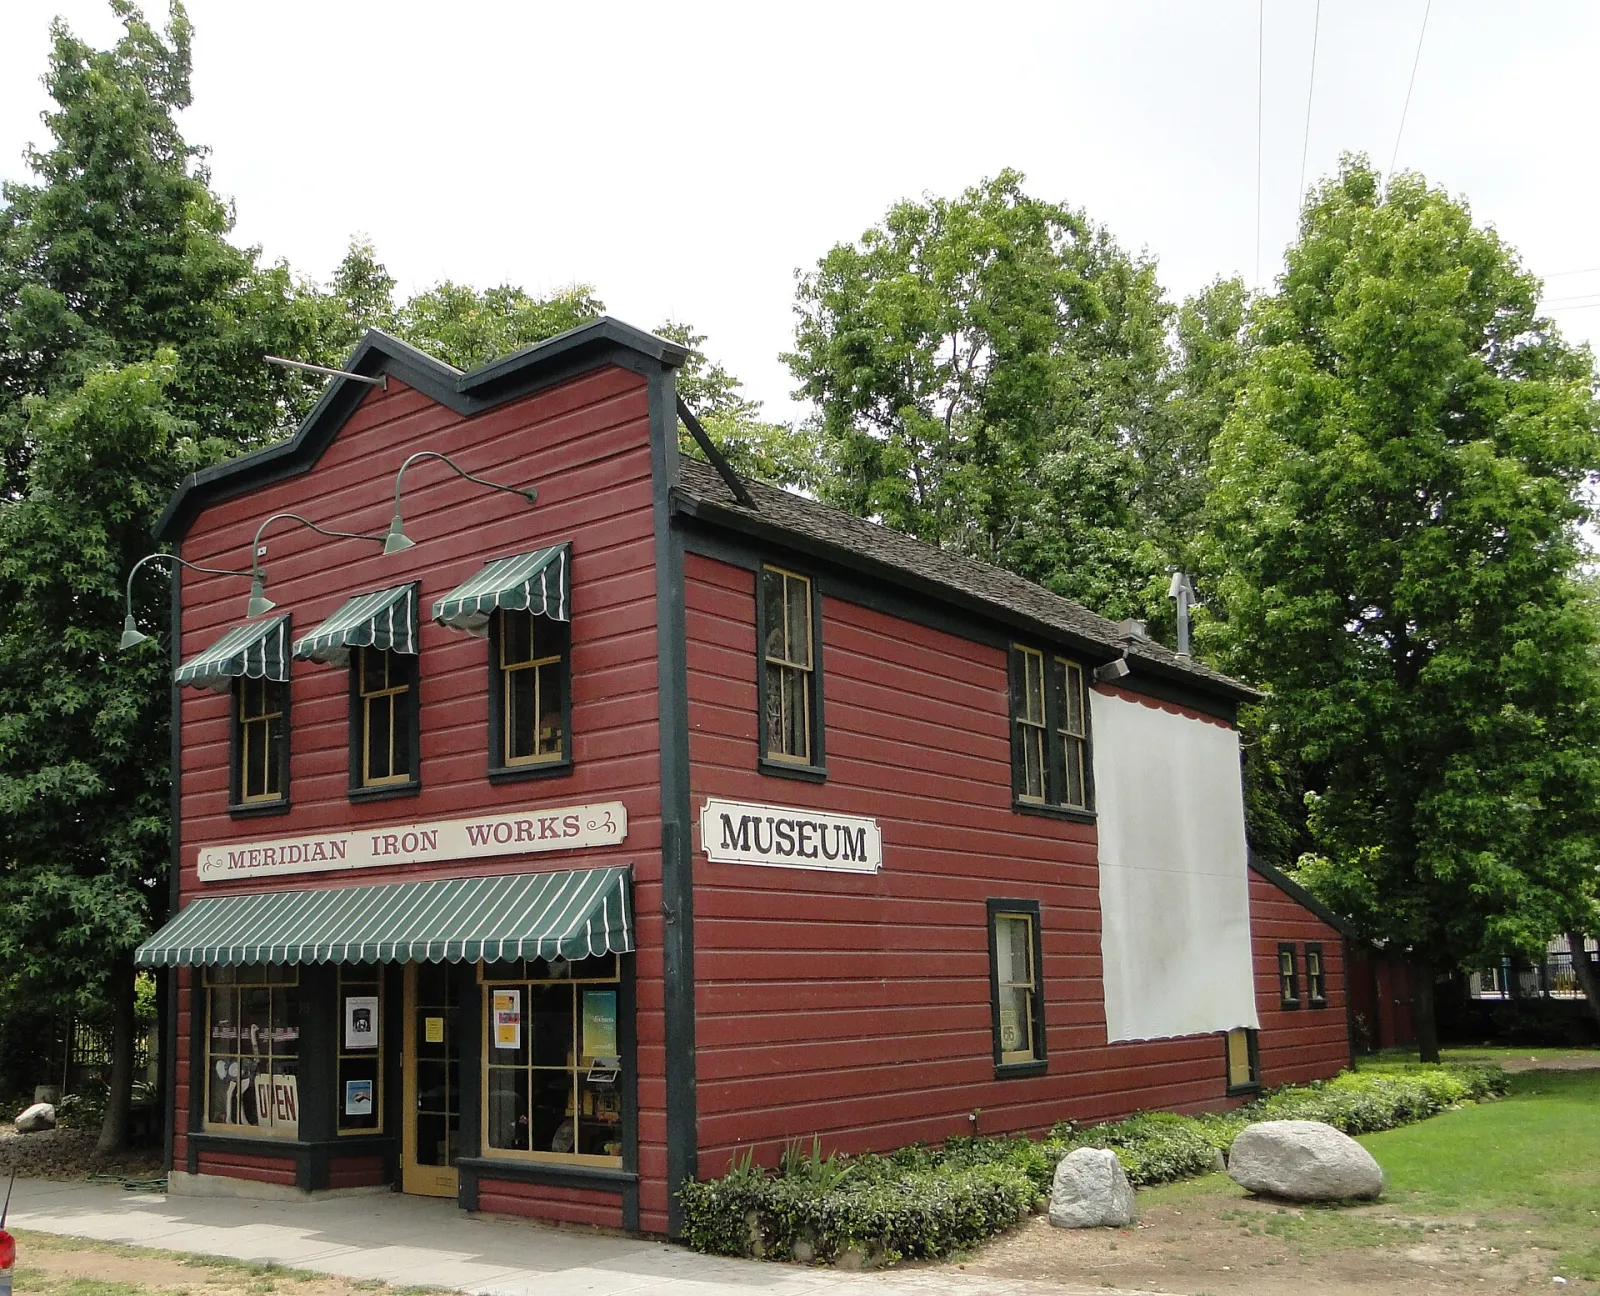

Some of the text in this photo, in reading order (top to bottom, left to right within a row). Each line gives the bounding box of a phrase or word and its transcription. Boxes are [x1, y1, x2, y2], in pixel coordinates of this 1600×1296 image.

[227, 814, 581, 869] MERIDIAN IRON WORKS
[720, 813, 867, 862] MUSEUM
